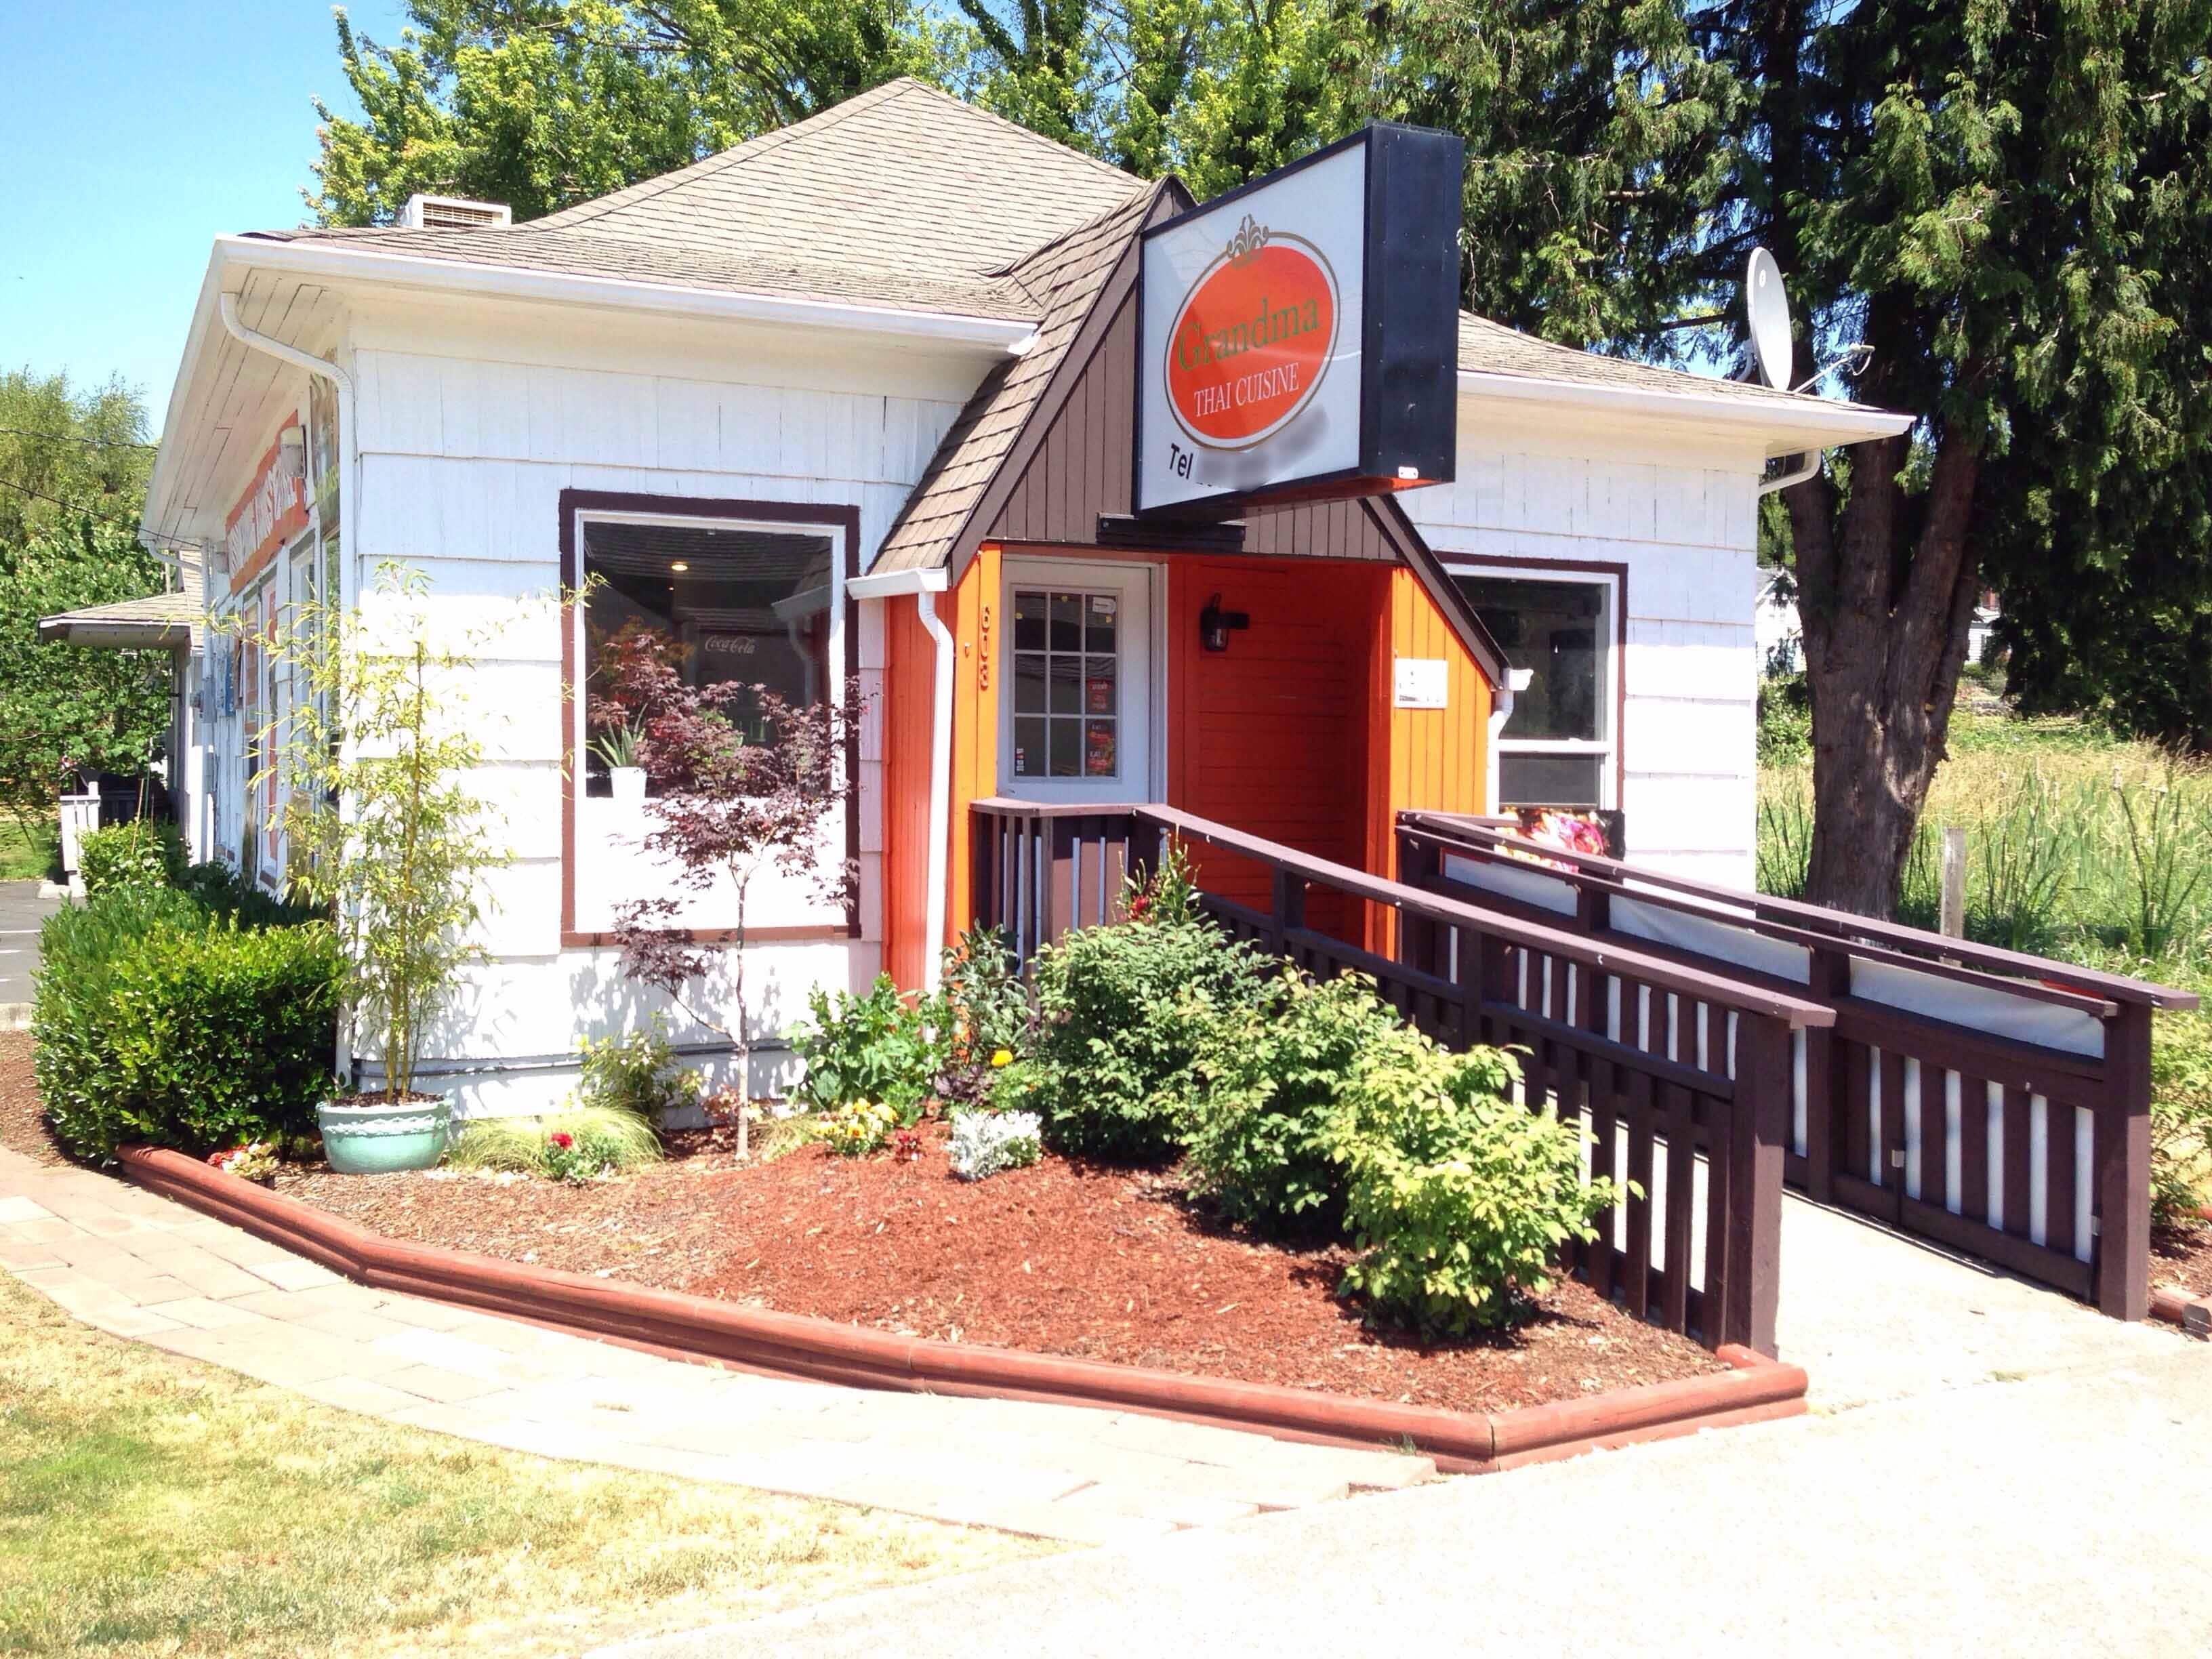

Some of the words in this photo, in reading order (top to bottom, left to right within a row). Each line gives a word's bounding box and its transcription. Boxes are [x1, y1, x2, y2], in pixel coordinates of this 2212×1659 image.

[1179, 297, 1319, 371] Grandma
[1194, 382, 1231, 417] THAI
[1235, 363, 1298, 406] CUISINE
[1170, 443, 1193, 479] Tel
